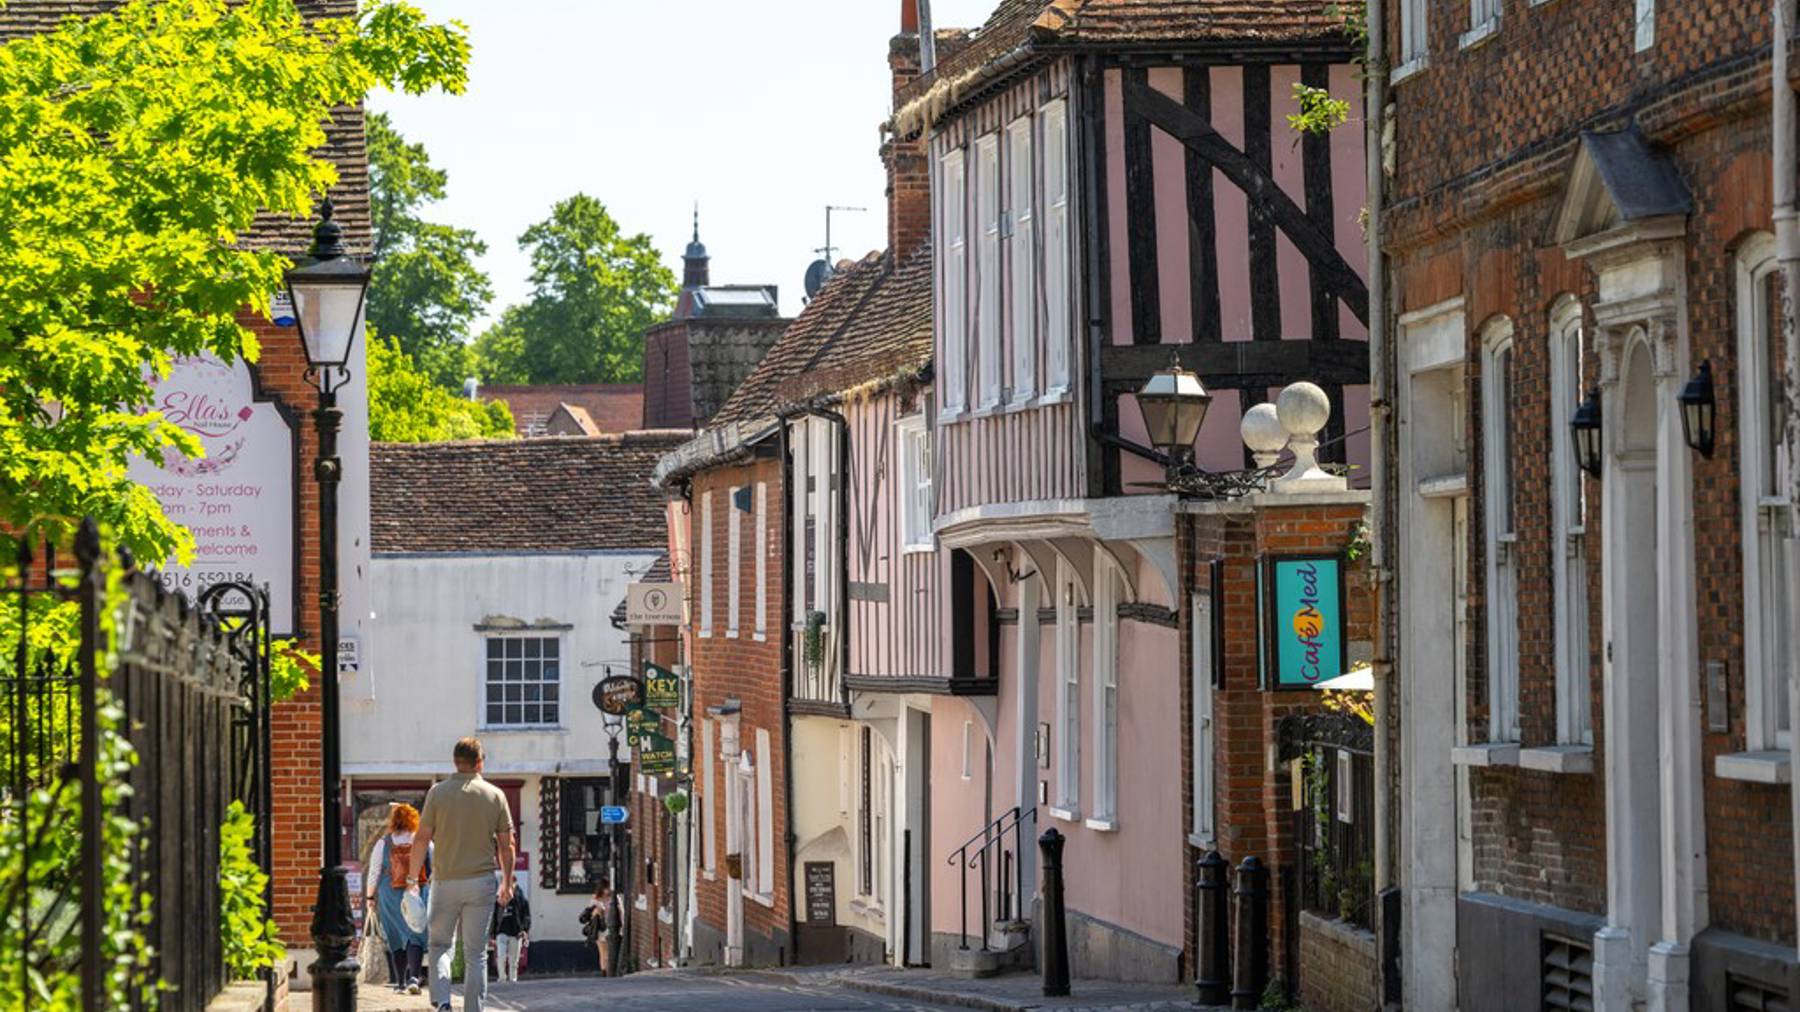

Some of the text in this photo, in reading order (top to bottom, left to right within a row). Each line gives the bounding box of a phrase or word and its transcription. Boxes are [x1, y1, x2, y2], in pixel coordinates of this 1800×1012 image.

[196, 484, 262, 498] Saturday
[199, 502, 232, 516] 7pm
[240, 525, 251, 537] &
[1296, 563, 1323, 681] Café Med
[647, 679, 677, 692] KEY
[642, 751, 673, 760] WATCH
